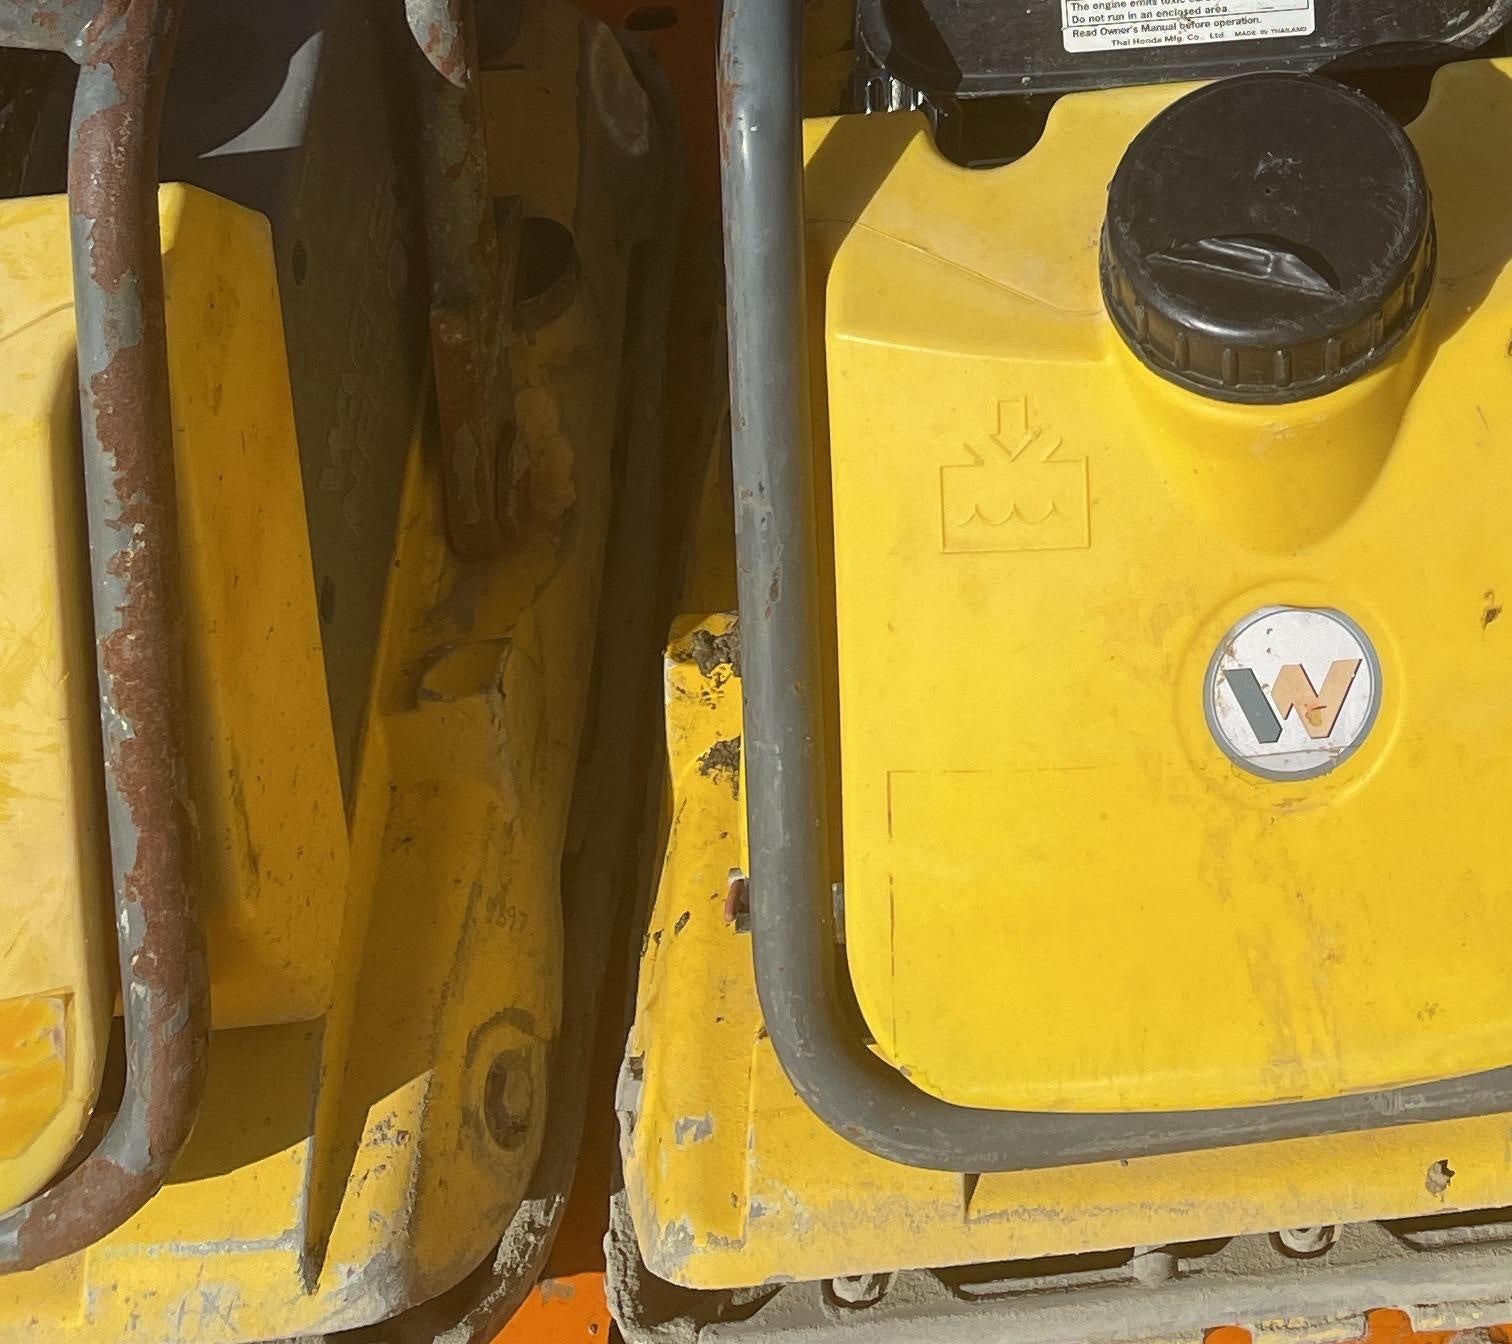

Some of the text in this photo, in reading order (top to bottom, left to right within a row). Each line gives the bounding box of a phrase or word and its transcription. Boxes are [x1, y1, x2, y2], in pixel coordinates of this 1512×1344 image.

[1070, 2, 1090, 13] The
[1093, 0, 1127, 13] engine
[1072, 15, 1086, 24] Do
[1088, 13, 1105, 23] not
[1108, 12, 1125, 22] run
[1128, 10, 1138, 20] in
[1141, 10, 1153, 19] an
[1156, 6, 1202, 18] enclosed
[1072, 16, 1263, 38] Read Owner's Manual before operation.
[1111, 38, 1131, 47] Thai
[1132, 36, 1162, 46] Honda
[1234, 29, 1257, 38] MADE
[1271, 25, 1308, 35] THAILAND
